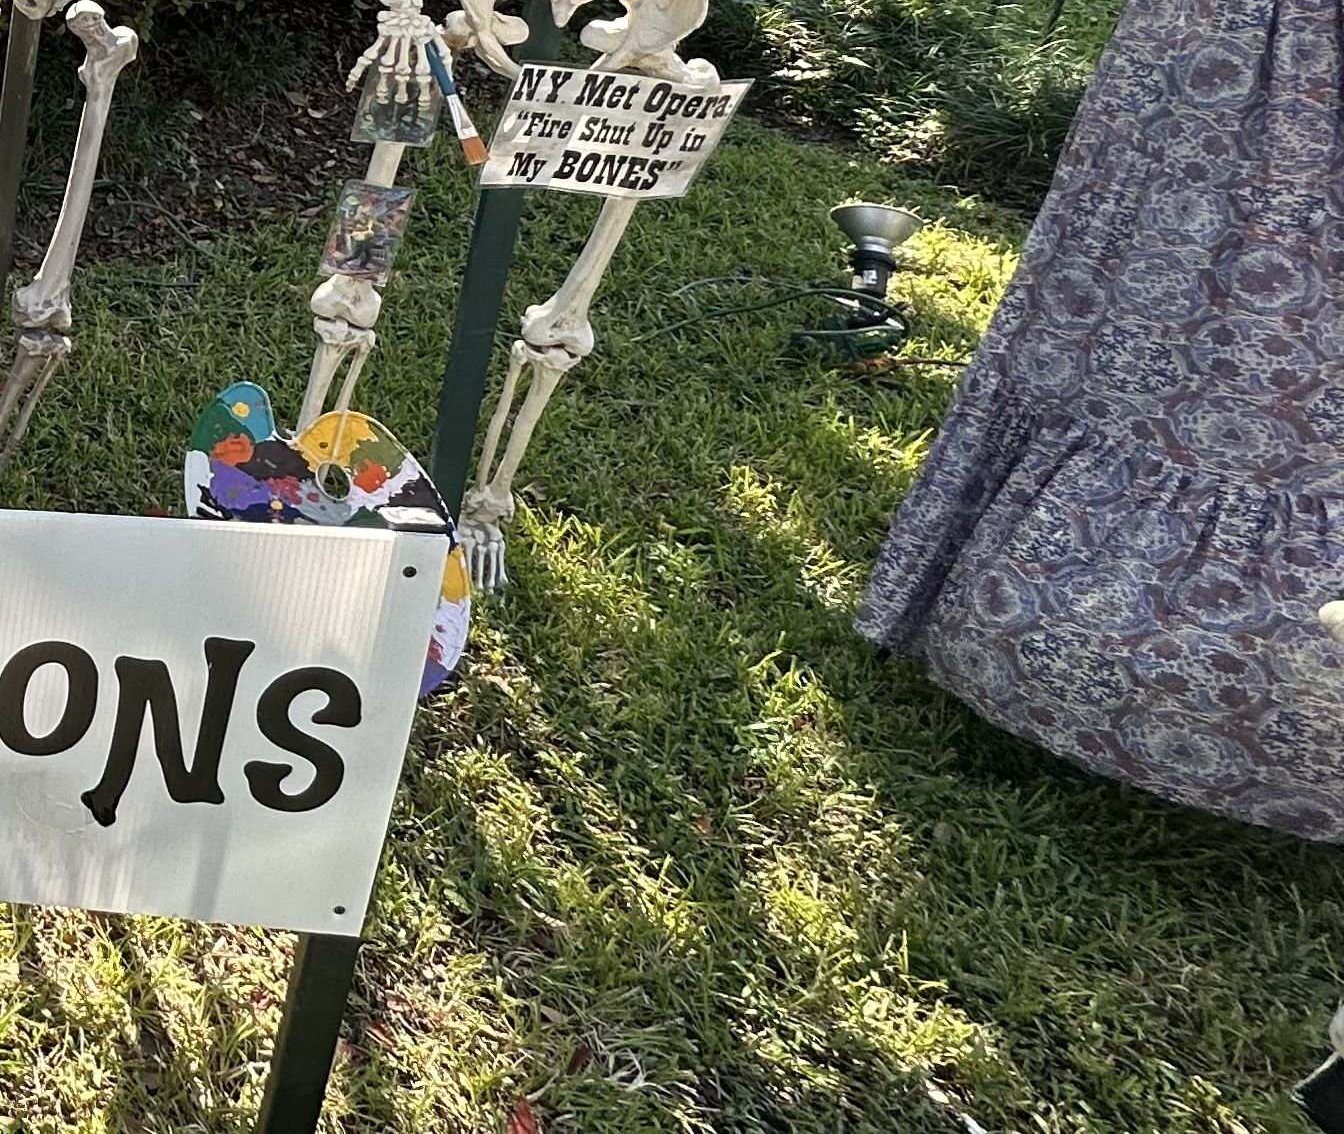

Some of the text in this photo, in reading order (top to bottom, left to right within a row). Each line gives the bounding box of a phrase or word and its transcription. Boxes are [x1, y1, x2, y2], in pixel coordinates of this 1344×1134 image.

[574, 73, 641, 111] Met
[579, 116, 636, 147] Shut
[642, 122, 674, 155] Up
[680, 127, 707, 154] in
[506, 152, 548, 183] My
